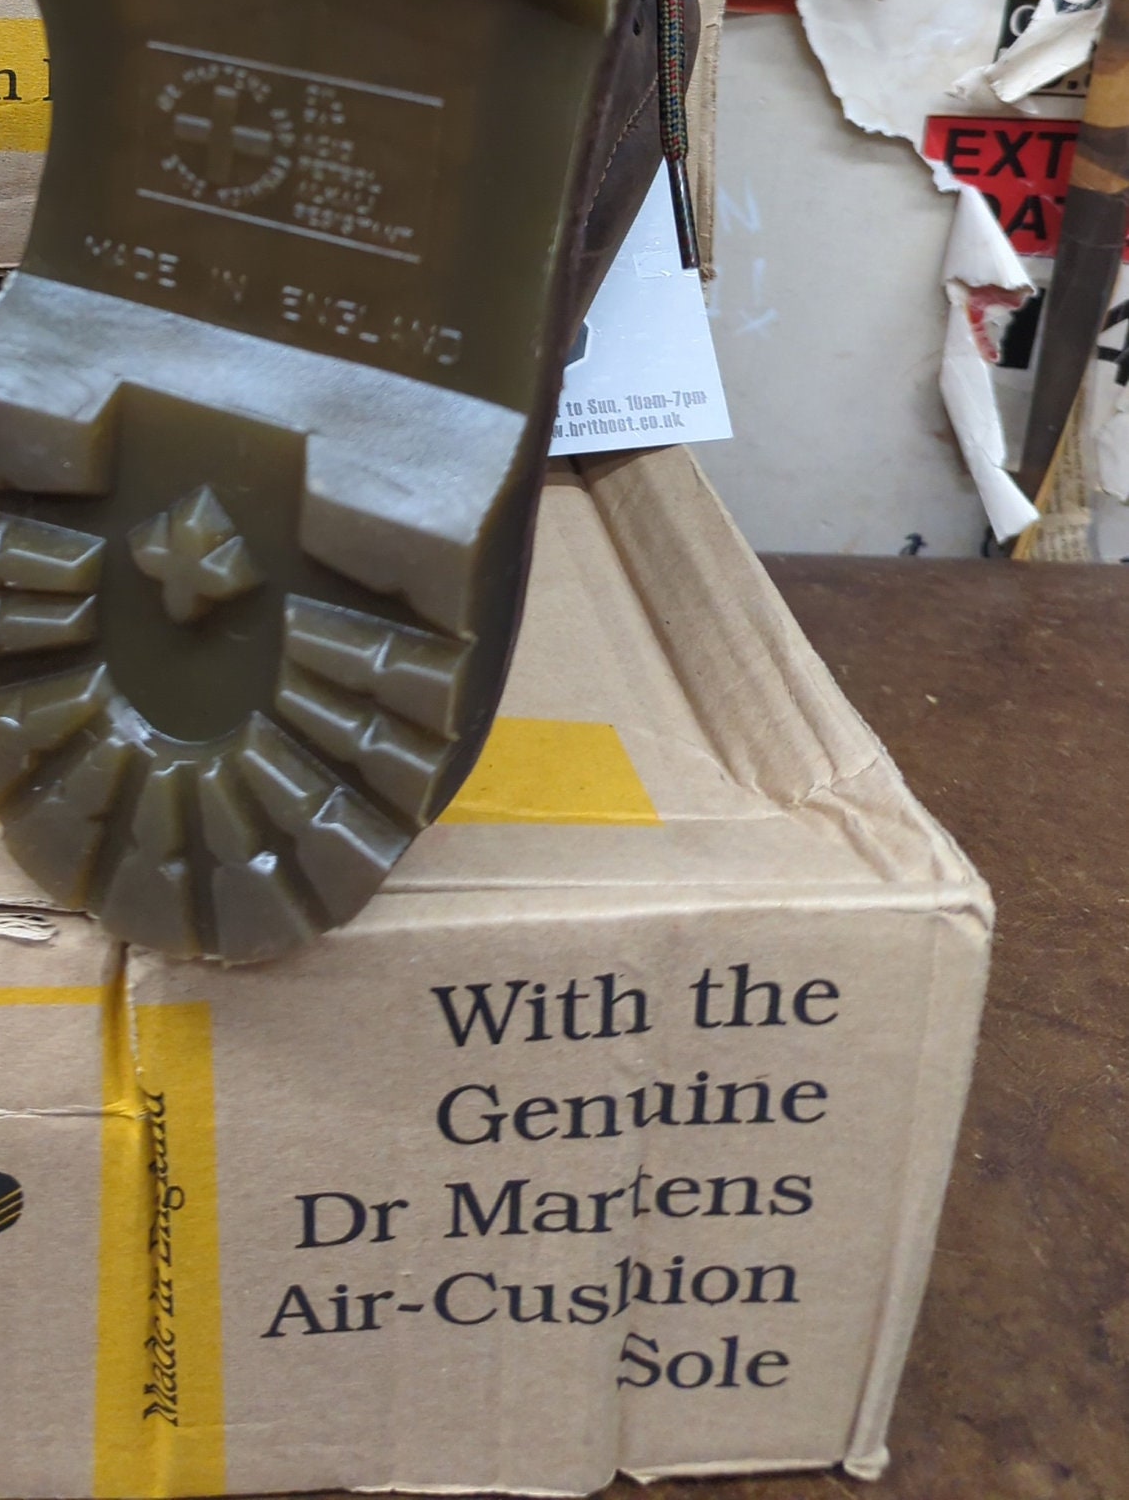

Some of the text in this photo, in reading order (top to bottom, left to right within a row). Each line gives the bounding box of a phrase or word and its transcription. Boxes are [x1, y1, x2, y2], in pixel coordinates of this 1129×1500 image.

[565, 401, 583, 417] to
[430, 963, 841, 1048] With the
[436, 1071, 829, 1146] Genuine
[293, 1164, 814, 1249] Dr Martens
[260, 1255, 801, 1339] Air-Cushion
[616, 1331, 790, 1391] Sole
